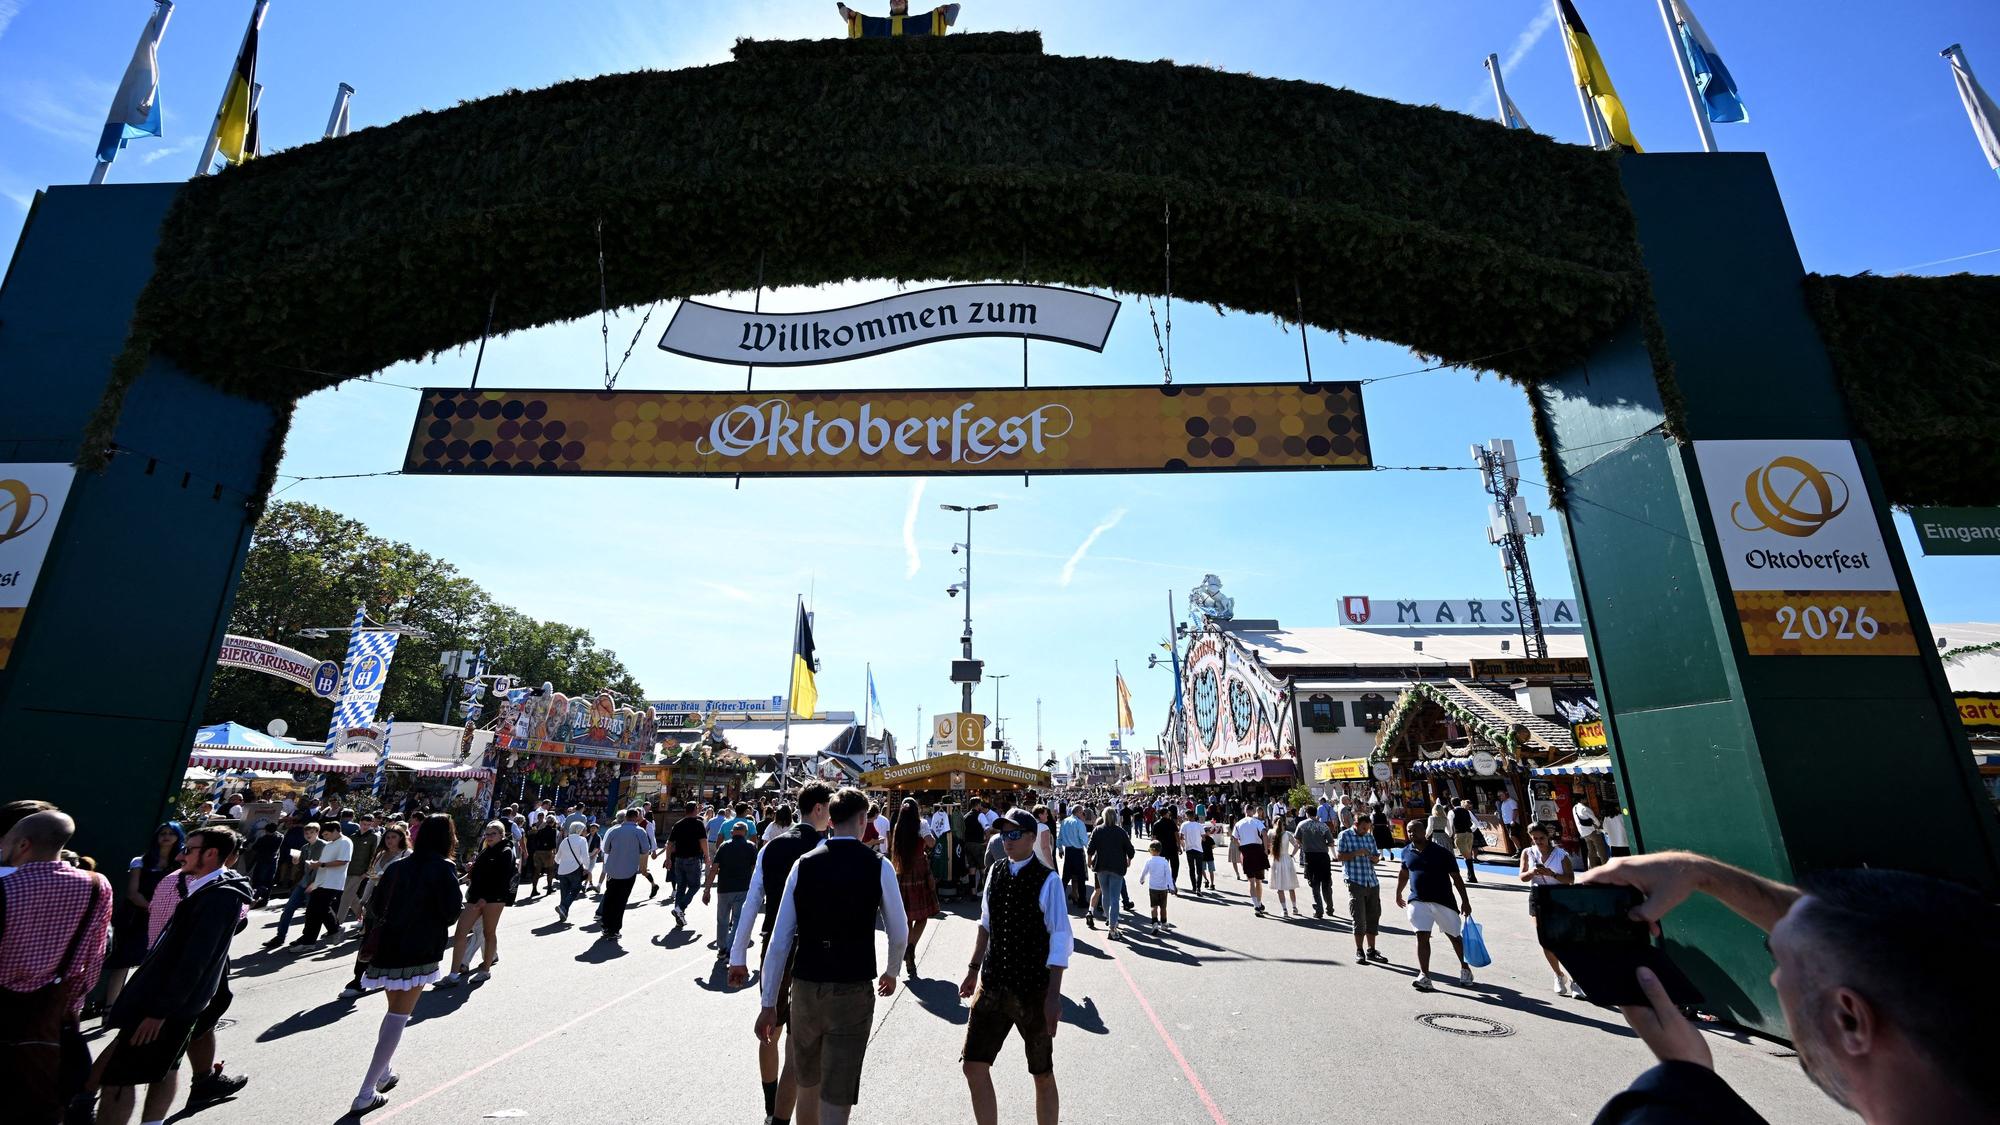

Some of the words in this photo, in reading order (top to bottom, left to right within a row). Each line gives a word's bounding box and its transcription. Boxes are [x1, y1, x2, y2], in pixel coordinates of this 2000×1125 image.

[738, 304, 958, 352] Willkommen
[968, 301, 1037, 325] zum
[696, 398, 1073, 464] Oktoberfest
[1745, 549, 1870, 573] Oktoberfest
[1396, 601, 1574, 623] MARSA
[1775, 605, 1879, 641] 2026
[219, 647, 313, 680] BIERKARUSSELL
[317, 677, 333, 692] HB
[573, 712, 591, 729] ALL
[599, 716, 624, 735] STARS
[1578, 722, 1605, 738] And
[884, 762, 932, 780] Souvenirs
[980, 761, 1037, 782] Information
